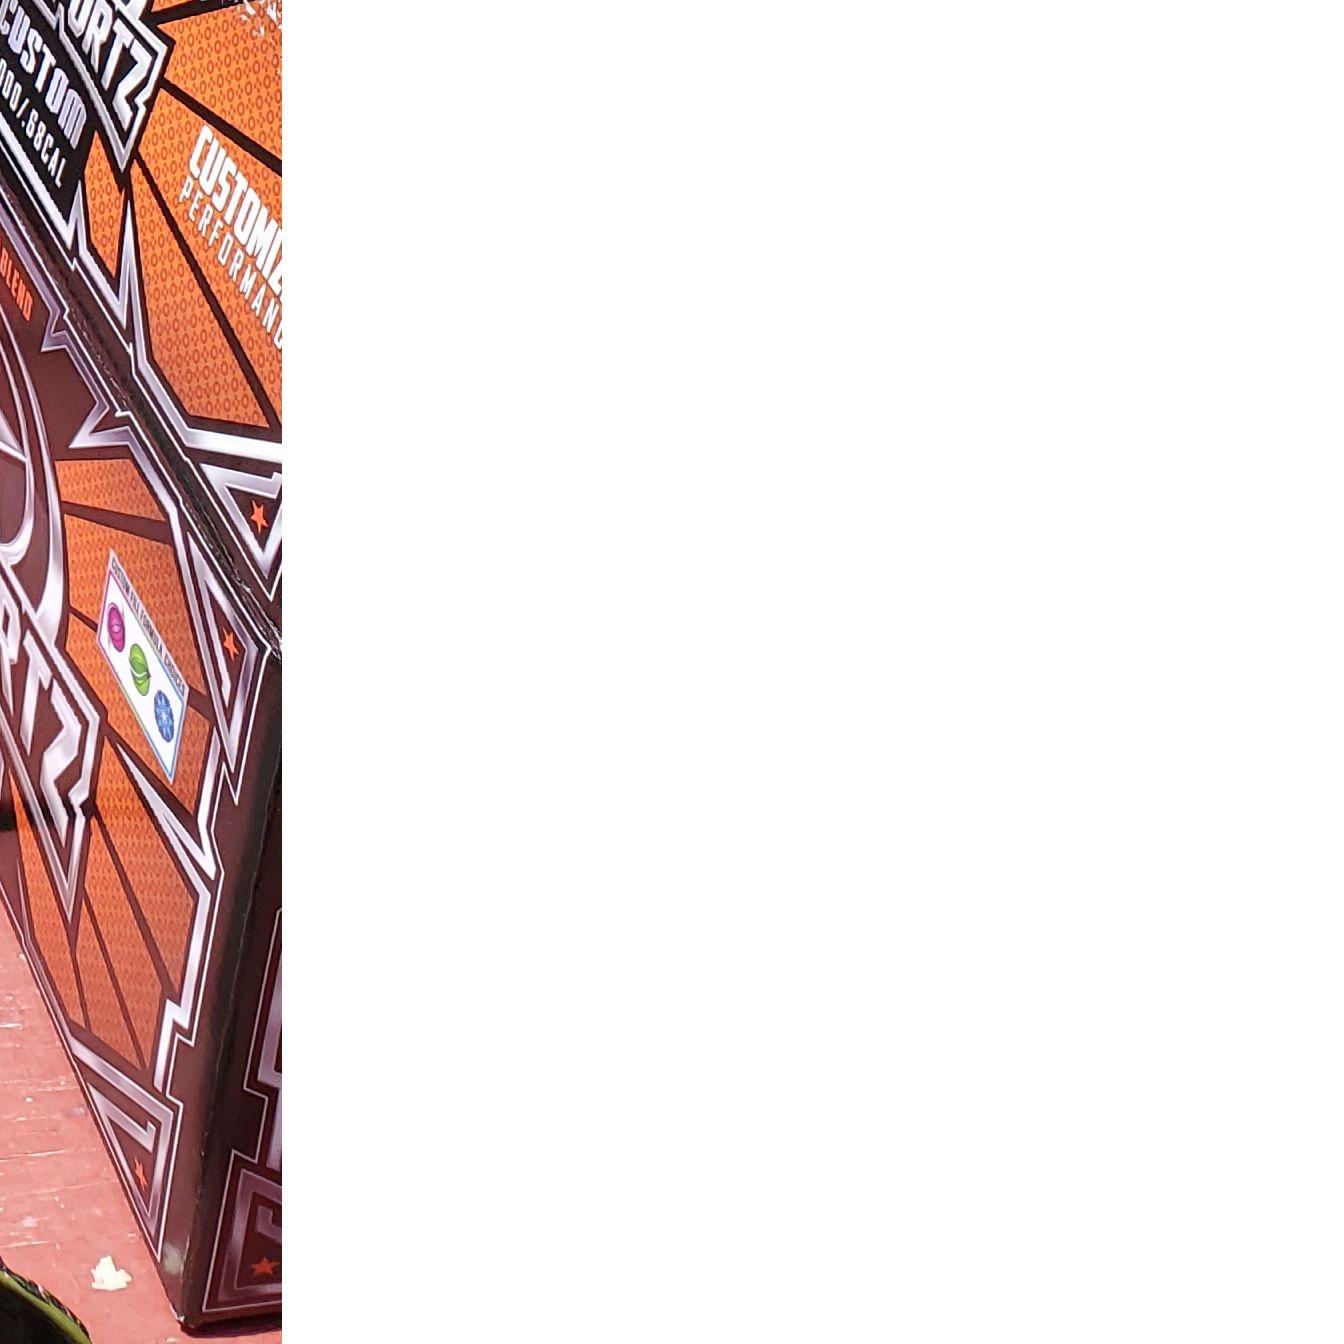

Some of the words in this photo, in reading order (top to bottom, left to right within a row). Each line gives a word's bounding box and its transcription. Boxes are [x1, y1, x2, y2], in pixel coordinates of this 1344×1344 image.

[0, 247, 33, 322] BLEND
[179, 175, 282, 351] PERFORMANC
[189, 125, 282, 300] CUSTOMIZ
